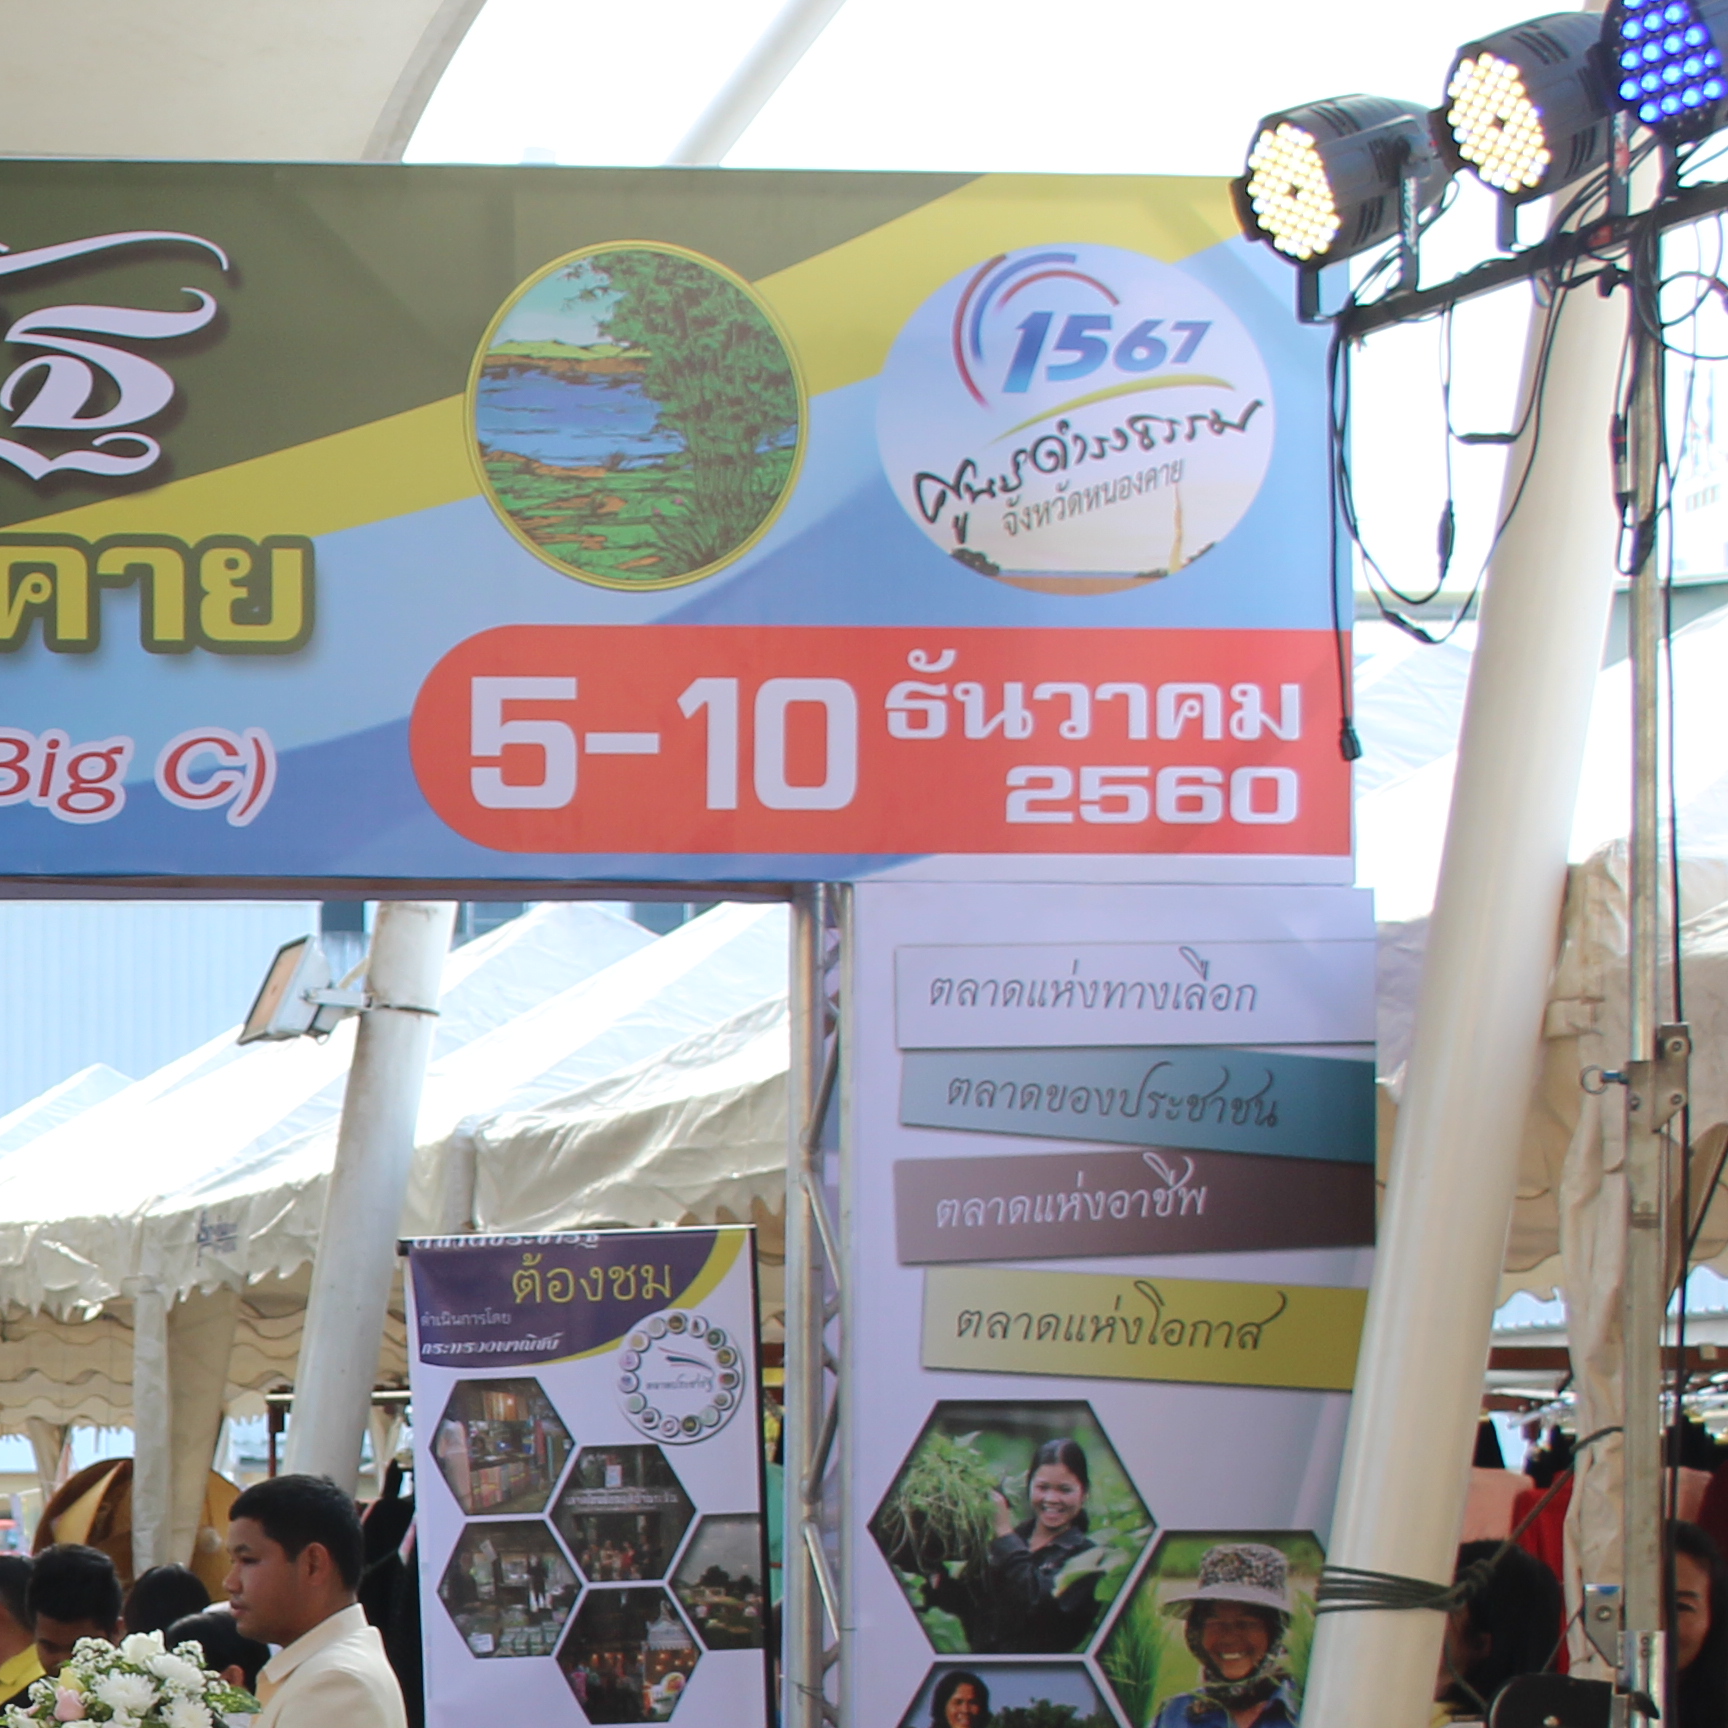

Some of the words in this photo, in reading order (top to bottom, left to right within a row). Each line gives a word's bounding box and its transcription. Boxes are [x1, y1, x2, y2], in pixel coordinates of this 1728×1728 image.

[1001, 311, 1213, 394] 1567
[913, 399, 1264, 545] ศูนย์ดำรงธรรม
[1002, 459, 1186, 536] จังหวัดหนองคาย
[885, 650, 1300, 743] ธันวาคม
[160, 732, 273, 820] C)
[470, 676, 859, 811] 5-10
[1006, 766, 1300, 823] 2560
[929, 947, 1257, 1013] ตลาดแห่งทางเลือก
[947, 1061, 1278, 1128] ตลาดของประชาชน
[936, 1152, 1207, 1228] ตลาดแห่งอาชีพ
[512, 1252, 673, 1304] ต้องชม
[956, 1281, 1287, 1350] ตลาดแห่งโอกาส
